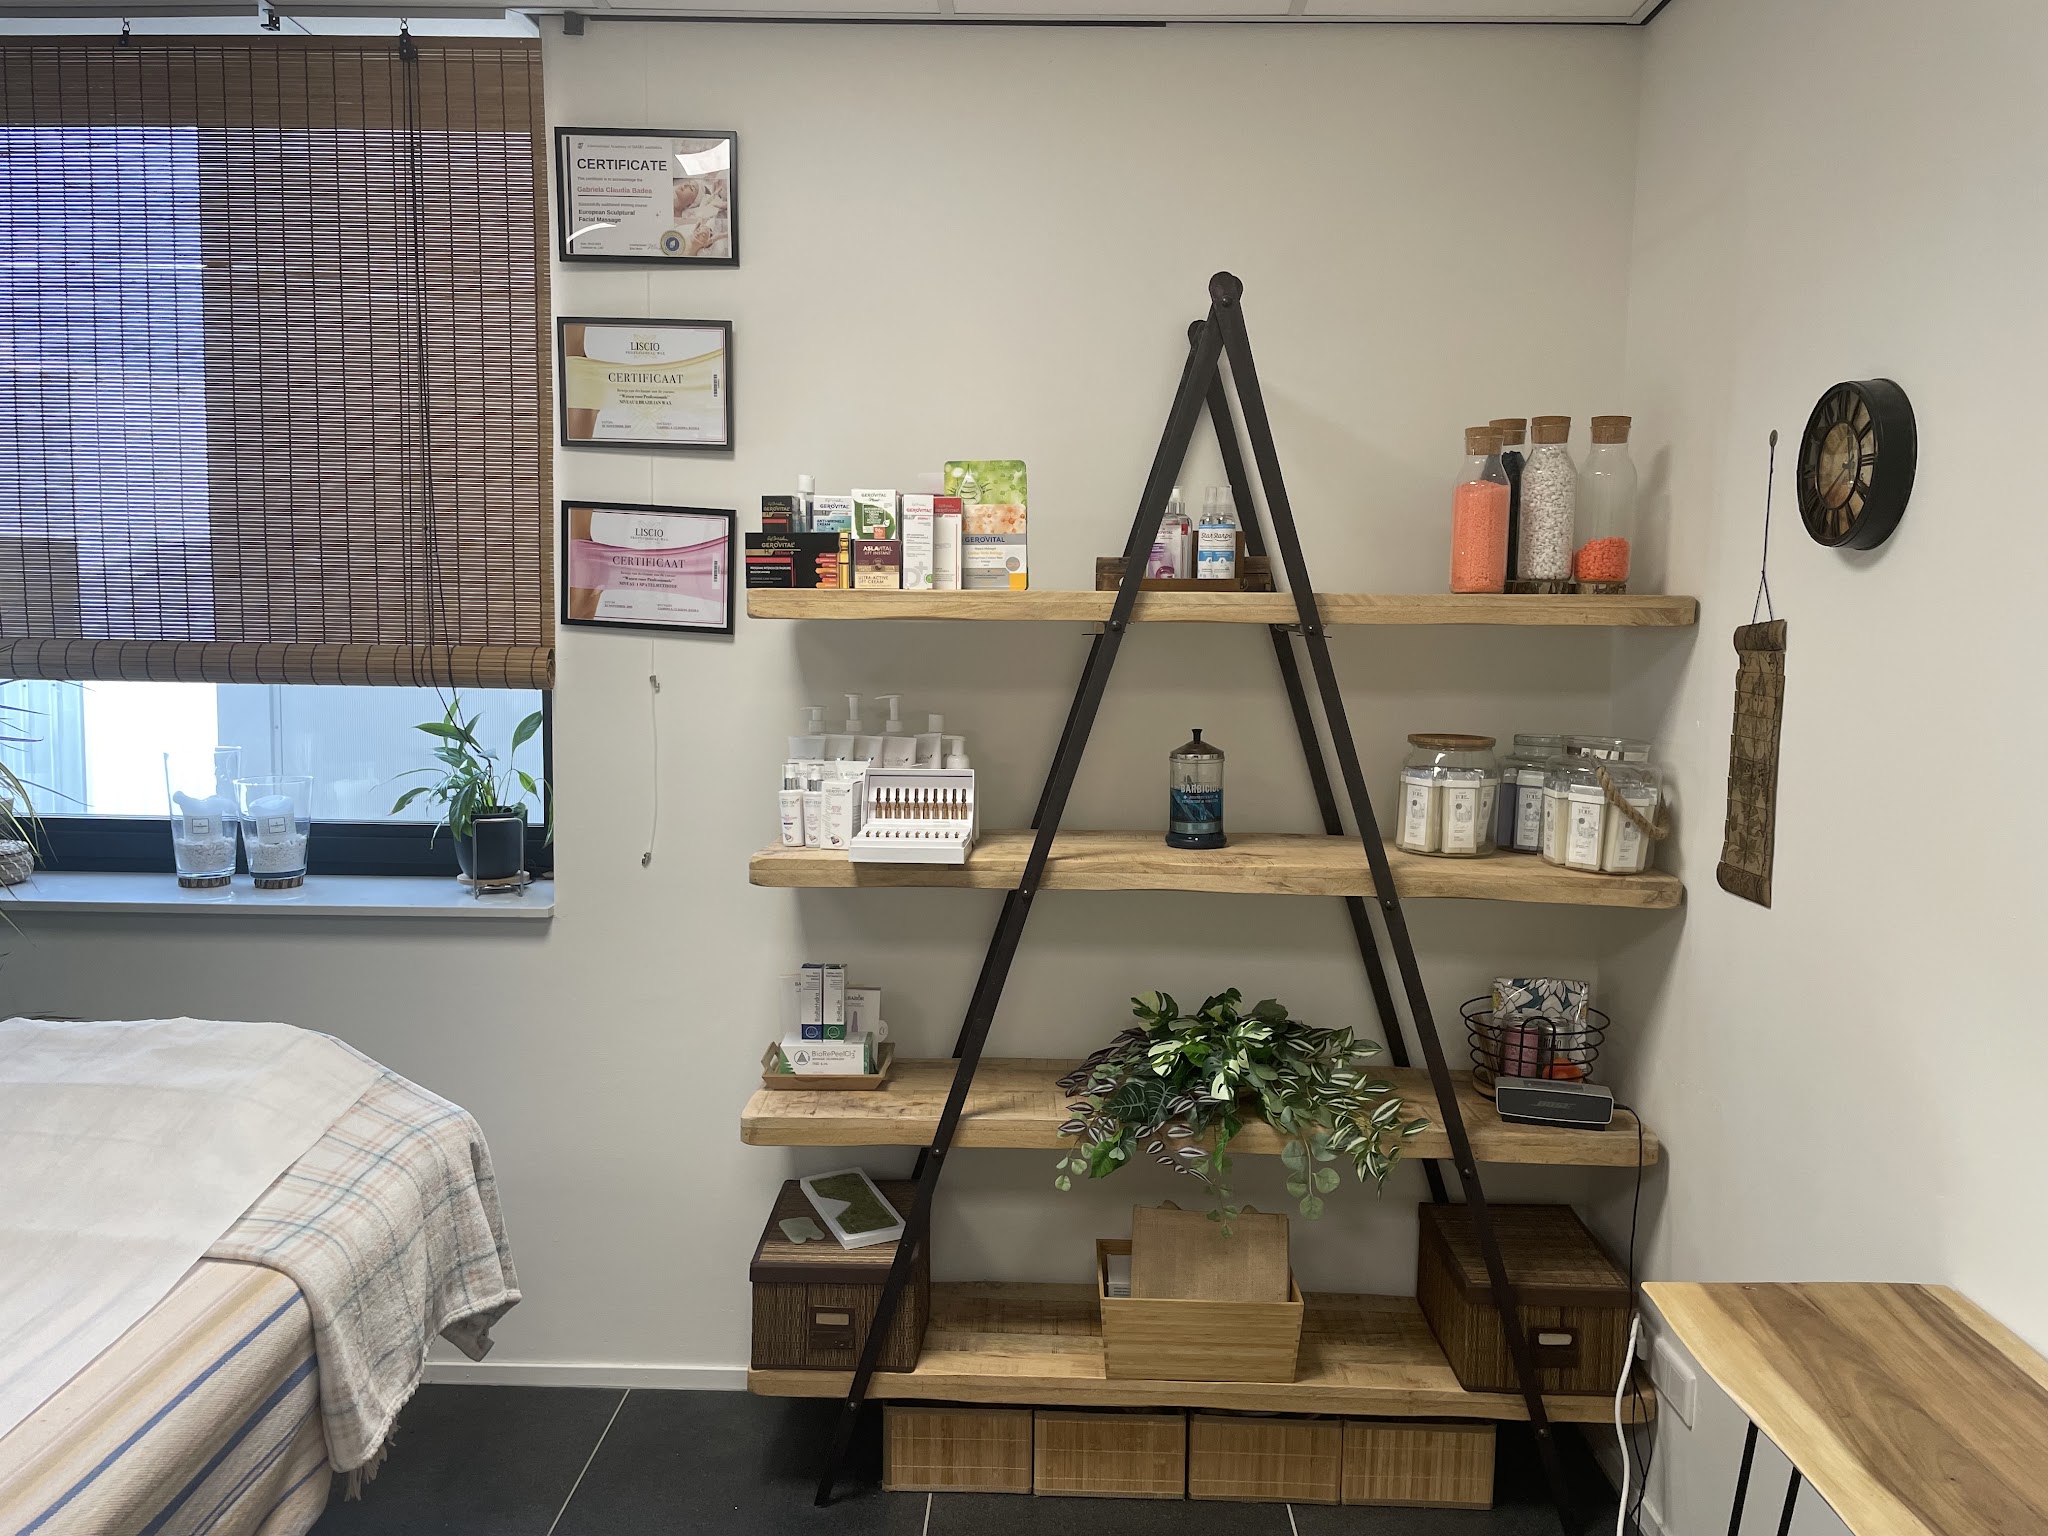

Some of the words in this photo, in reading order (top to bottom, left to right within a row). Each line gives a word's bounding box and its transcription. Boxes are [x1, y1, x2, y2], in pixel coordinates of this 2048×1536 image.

[577, 158, 668, 172] CERTIFICATE
[630, 342, 660, 352] LISCIO
[608, 372, 684, 384] CERTIFICAAT
[635, 528, 664, 538] LISCIO
[762, 541, 796, 549] GEROVITAL
[612, 555, 686, 568] CERTIFICAAT
